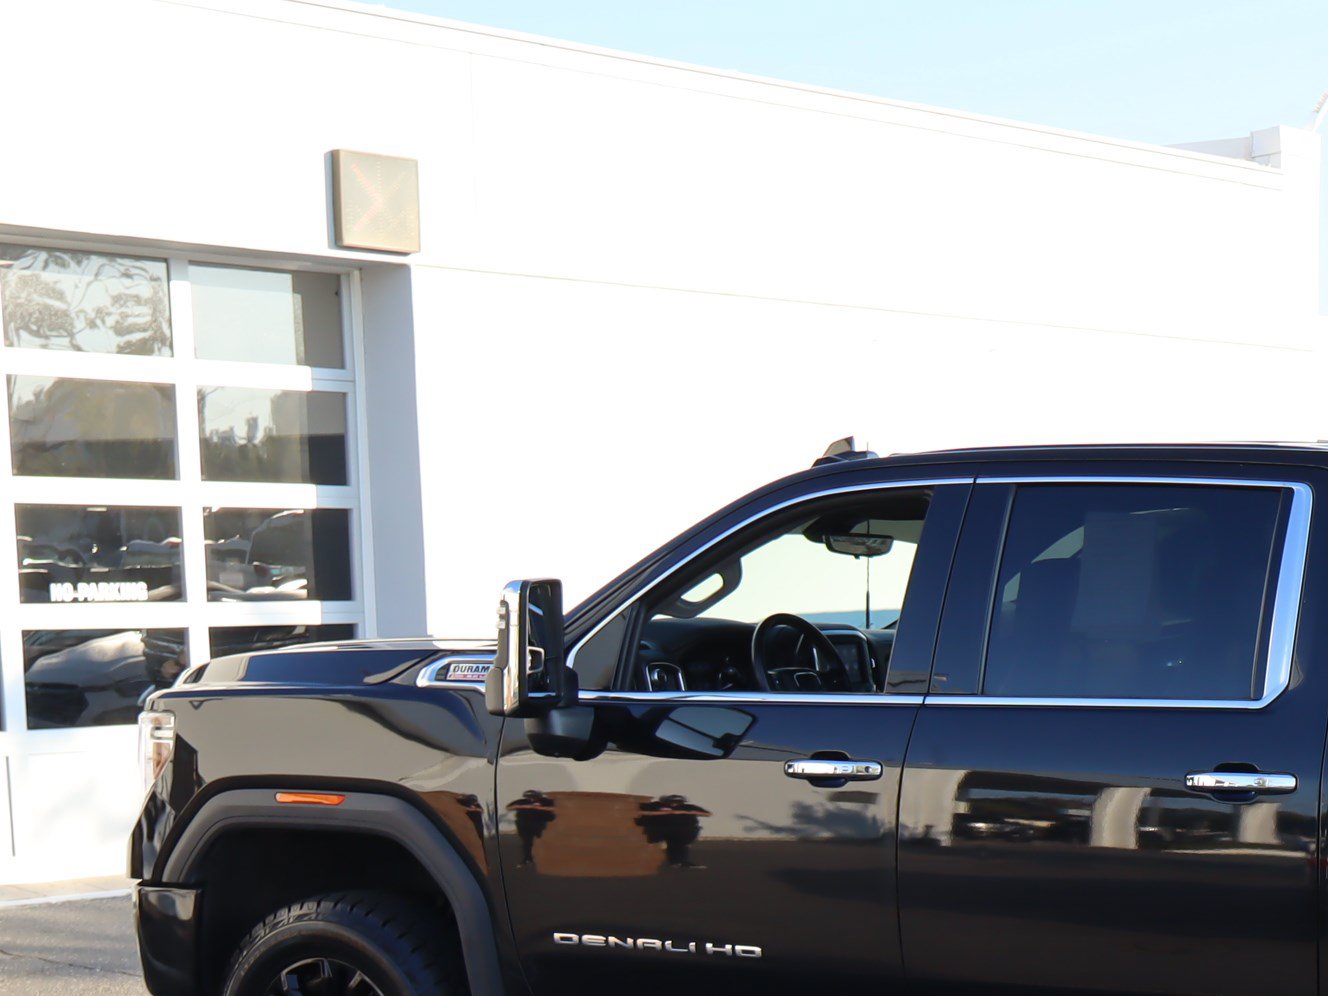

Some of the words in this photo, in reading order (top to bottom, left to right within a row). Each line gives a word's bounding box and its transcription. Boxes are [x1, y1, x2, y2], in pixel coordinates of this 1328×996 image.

[50, 582, 74, 602] NO
[77, 581, 149, 602] PARKING
[453, 665, 491, 673] DURAM
[553, 932, 697, 953] DENALI
[705, 942, 763, 958] HD
